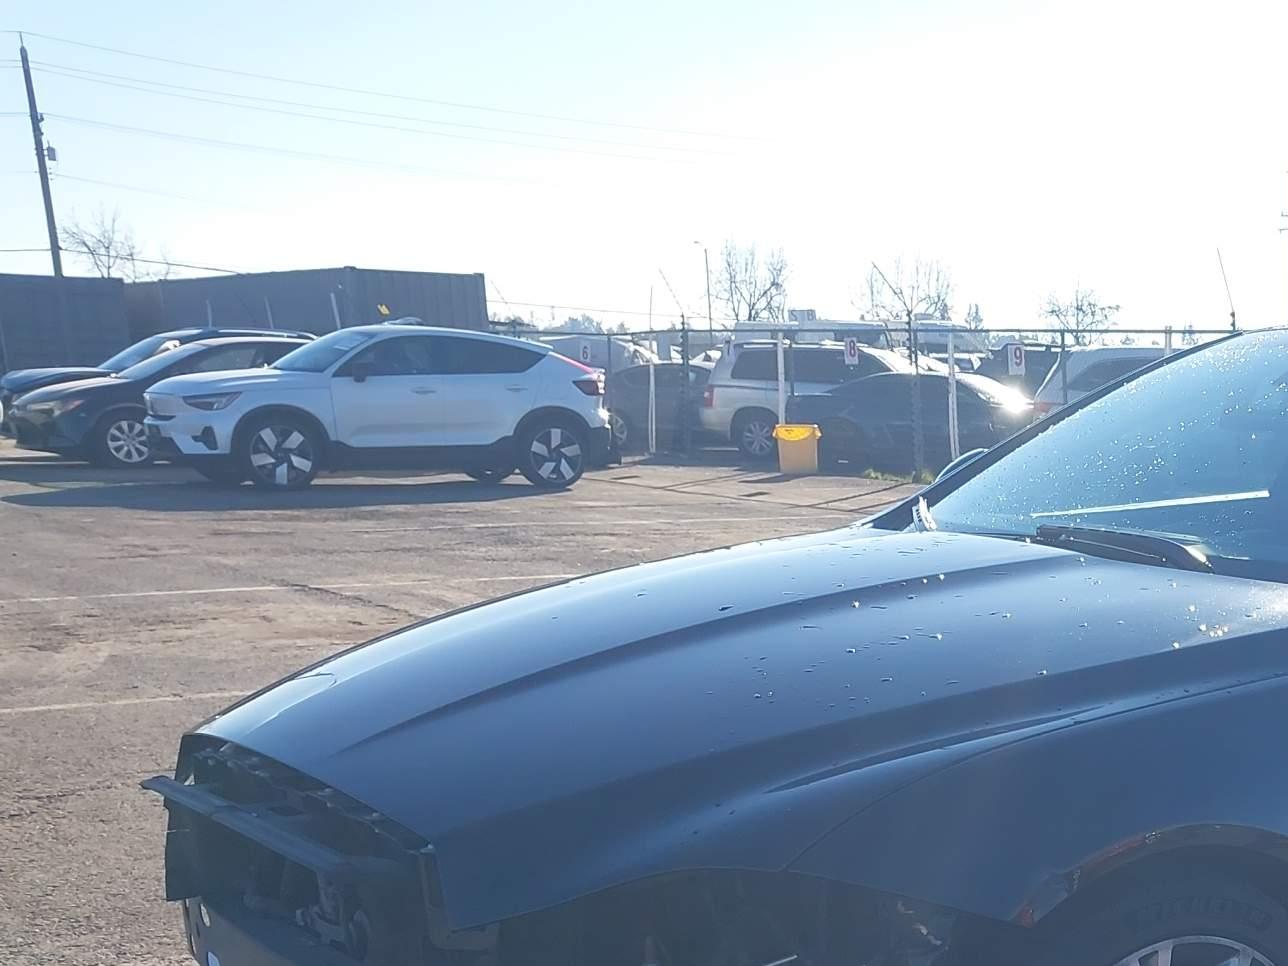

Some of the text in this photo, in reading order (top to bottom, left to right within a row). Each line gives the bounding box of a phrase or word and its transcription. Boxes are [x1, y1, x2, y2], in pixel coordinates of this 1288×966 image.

[582, 345, 589, 360] 6
[849, 340, 857, 358] 8
[1014, 346, 1023, 367] 9
